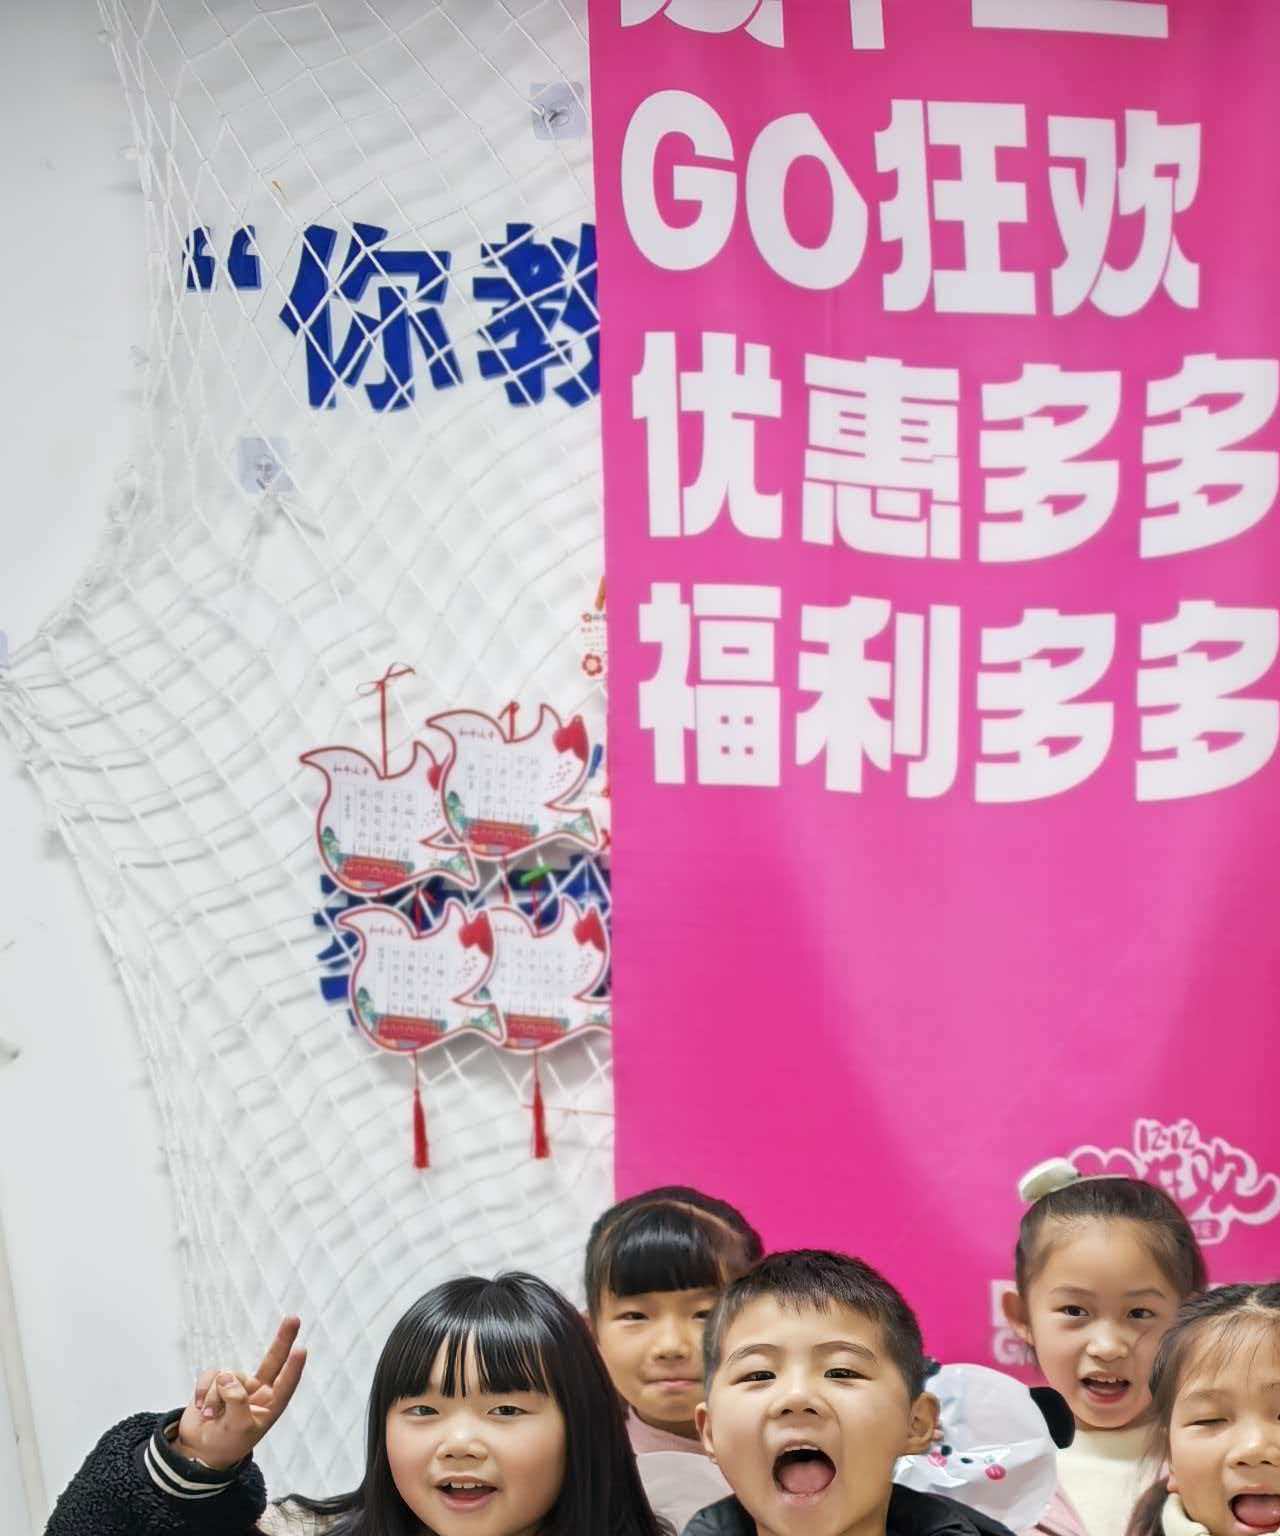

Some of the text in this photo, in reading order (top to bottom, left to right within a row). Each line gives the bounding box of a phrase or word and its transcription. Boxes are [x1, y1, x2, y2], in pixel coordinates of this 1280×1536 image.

[621, 88, 1201, 317] GO狂欢
[632, 331, 1280, 563] 优惠多多
[638, 582, 1280, 803] 福利多多
